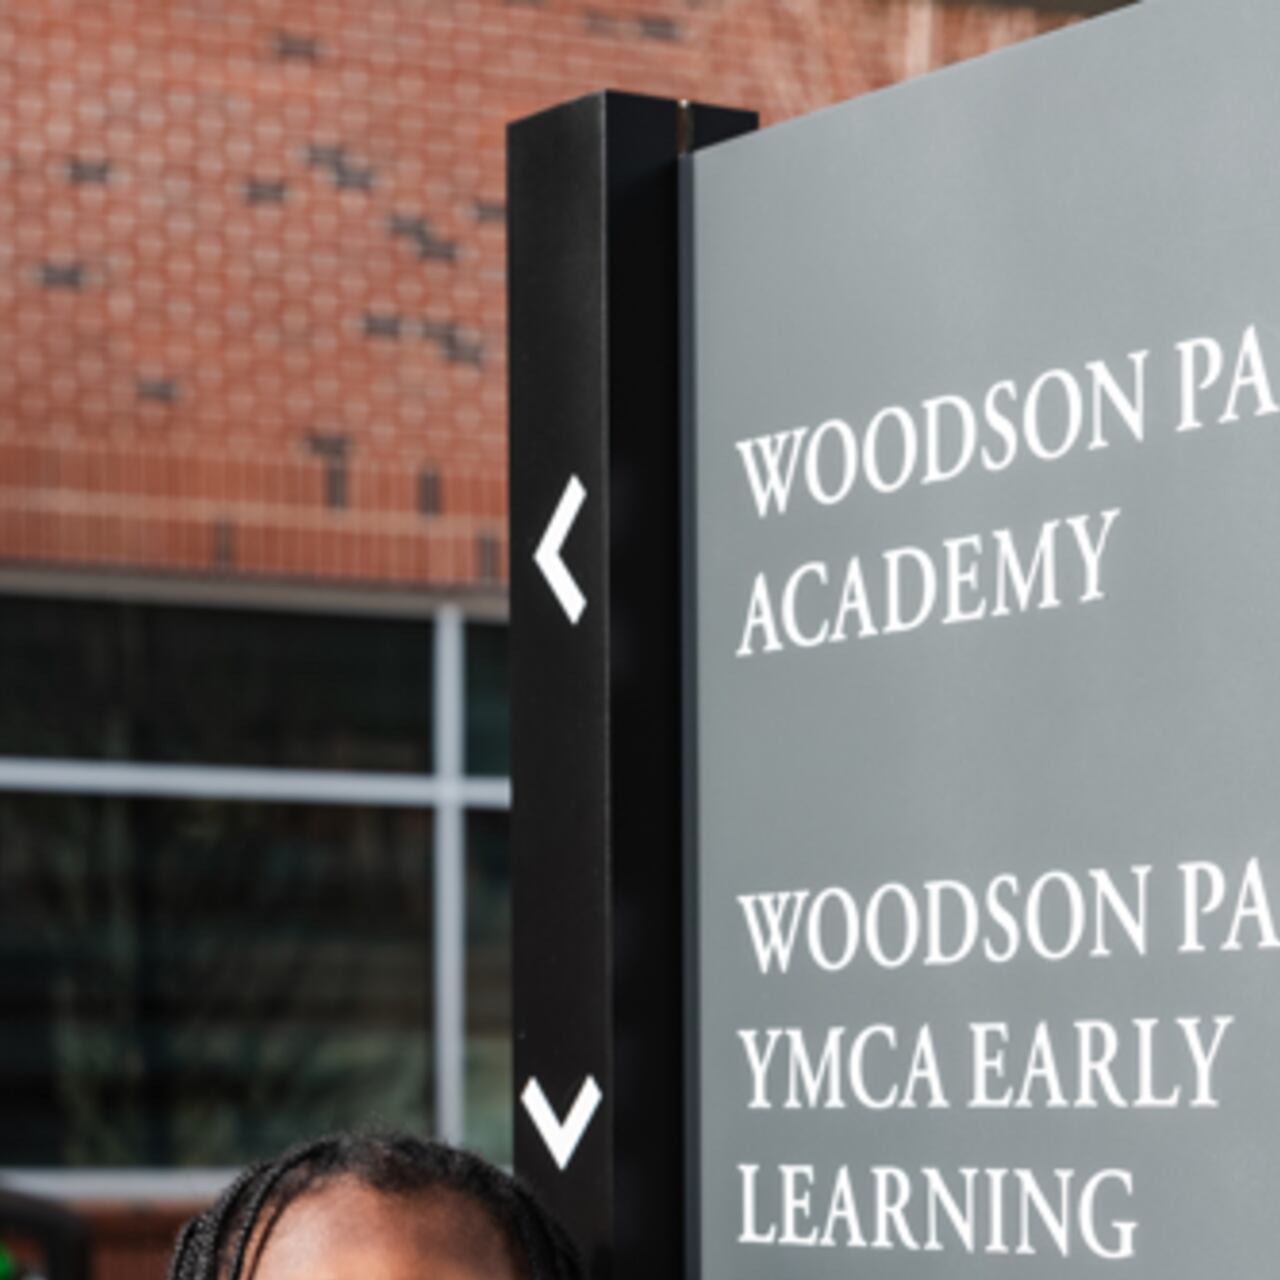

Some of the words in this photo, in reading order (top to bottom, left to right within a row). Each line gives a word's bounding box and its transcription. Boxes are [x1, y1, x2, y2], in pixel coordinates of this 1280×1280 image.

[733, 347, 1153, 519] WOODSON
[734, 506, 1122, 658] ACADEMY
[735, 863, 1153, 974] WOODSON
[737, 1023, 951, 1110] YMCA
[966, 1014, 1236, 1109] EARLY
[737, 1162, 1139, 1260] LEARNING
